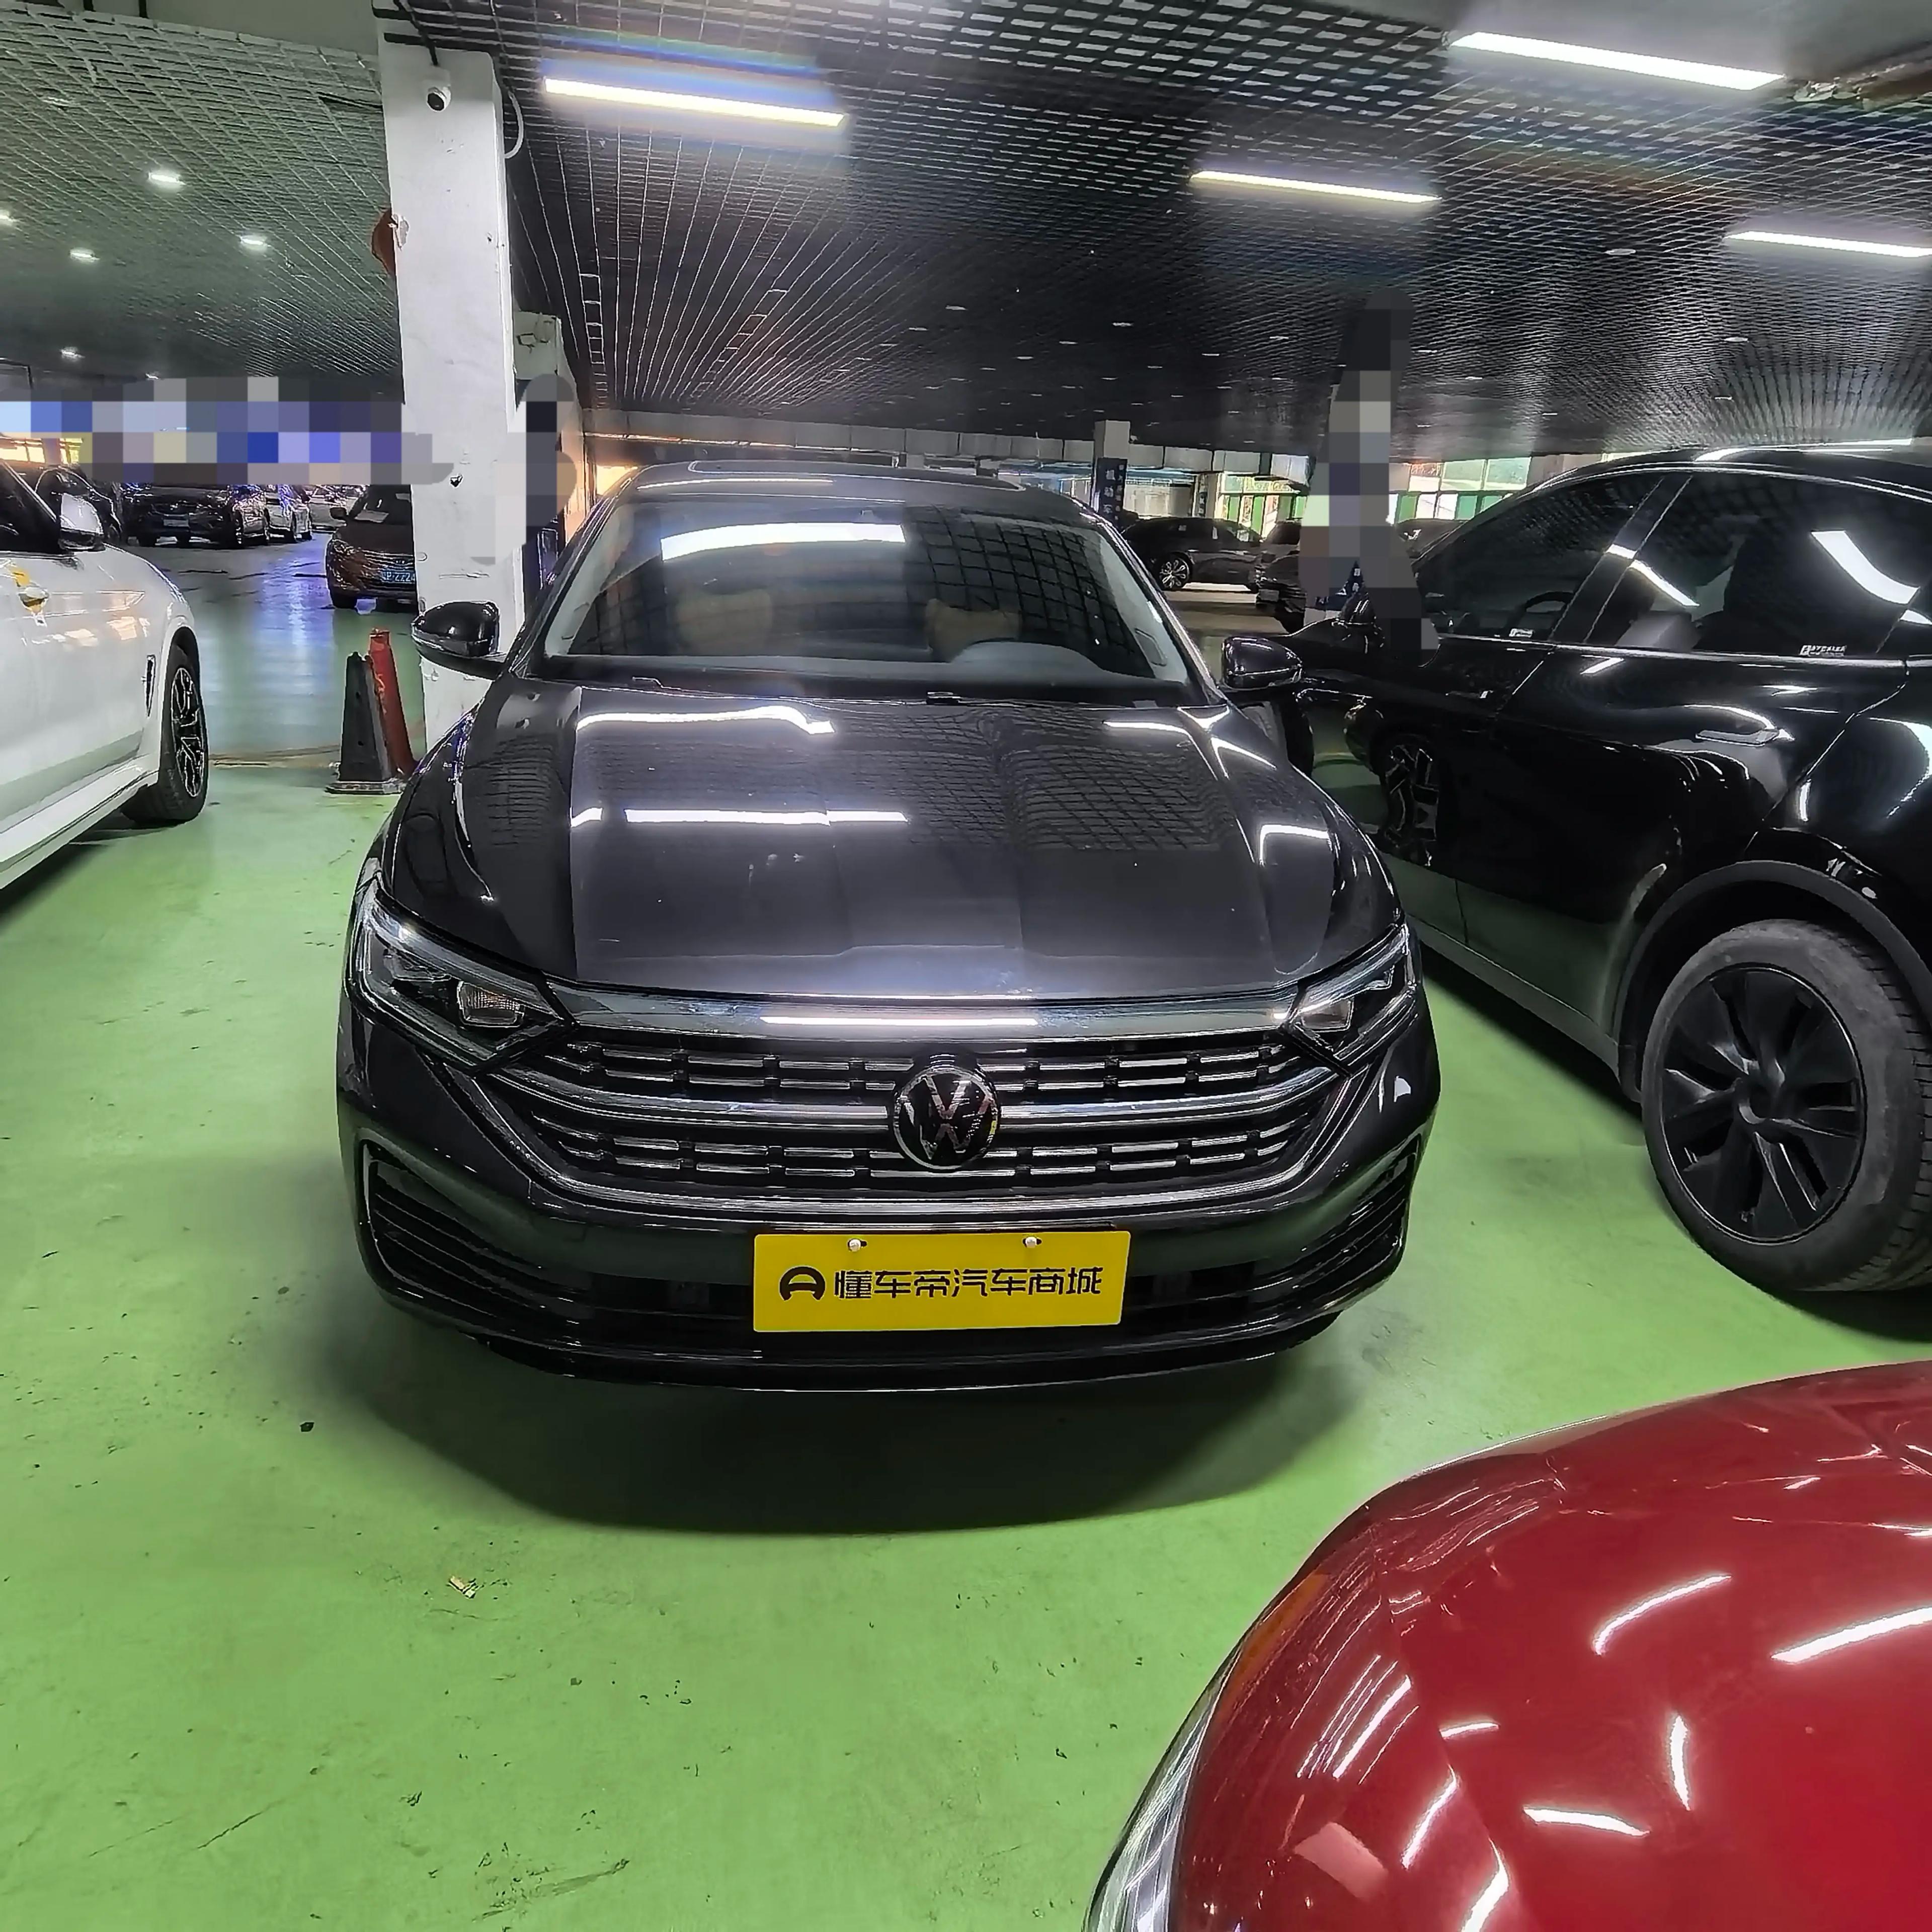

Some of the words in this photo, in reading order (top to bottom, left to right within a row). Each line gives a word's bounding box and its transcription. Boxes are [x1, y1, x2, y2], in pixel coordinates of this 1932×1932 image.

[834, 1266, 1103, 1299] 懂车帝汽车商城
